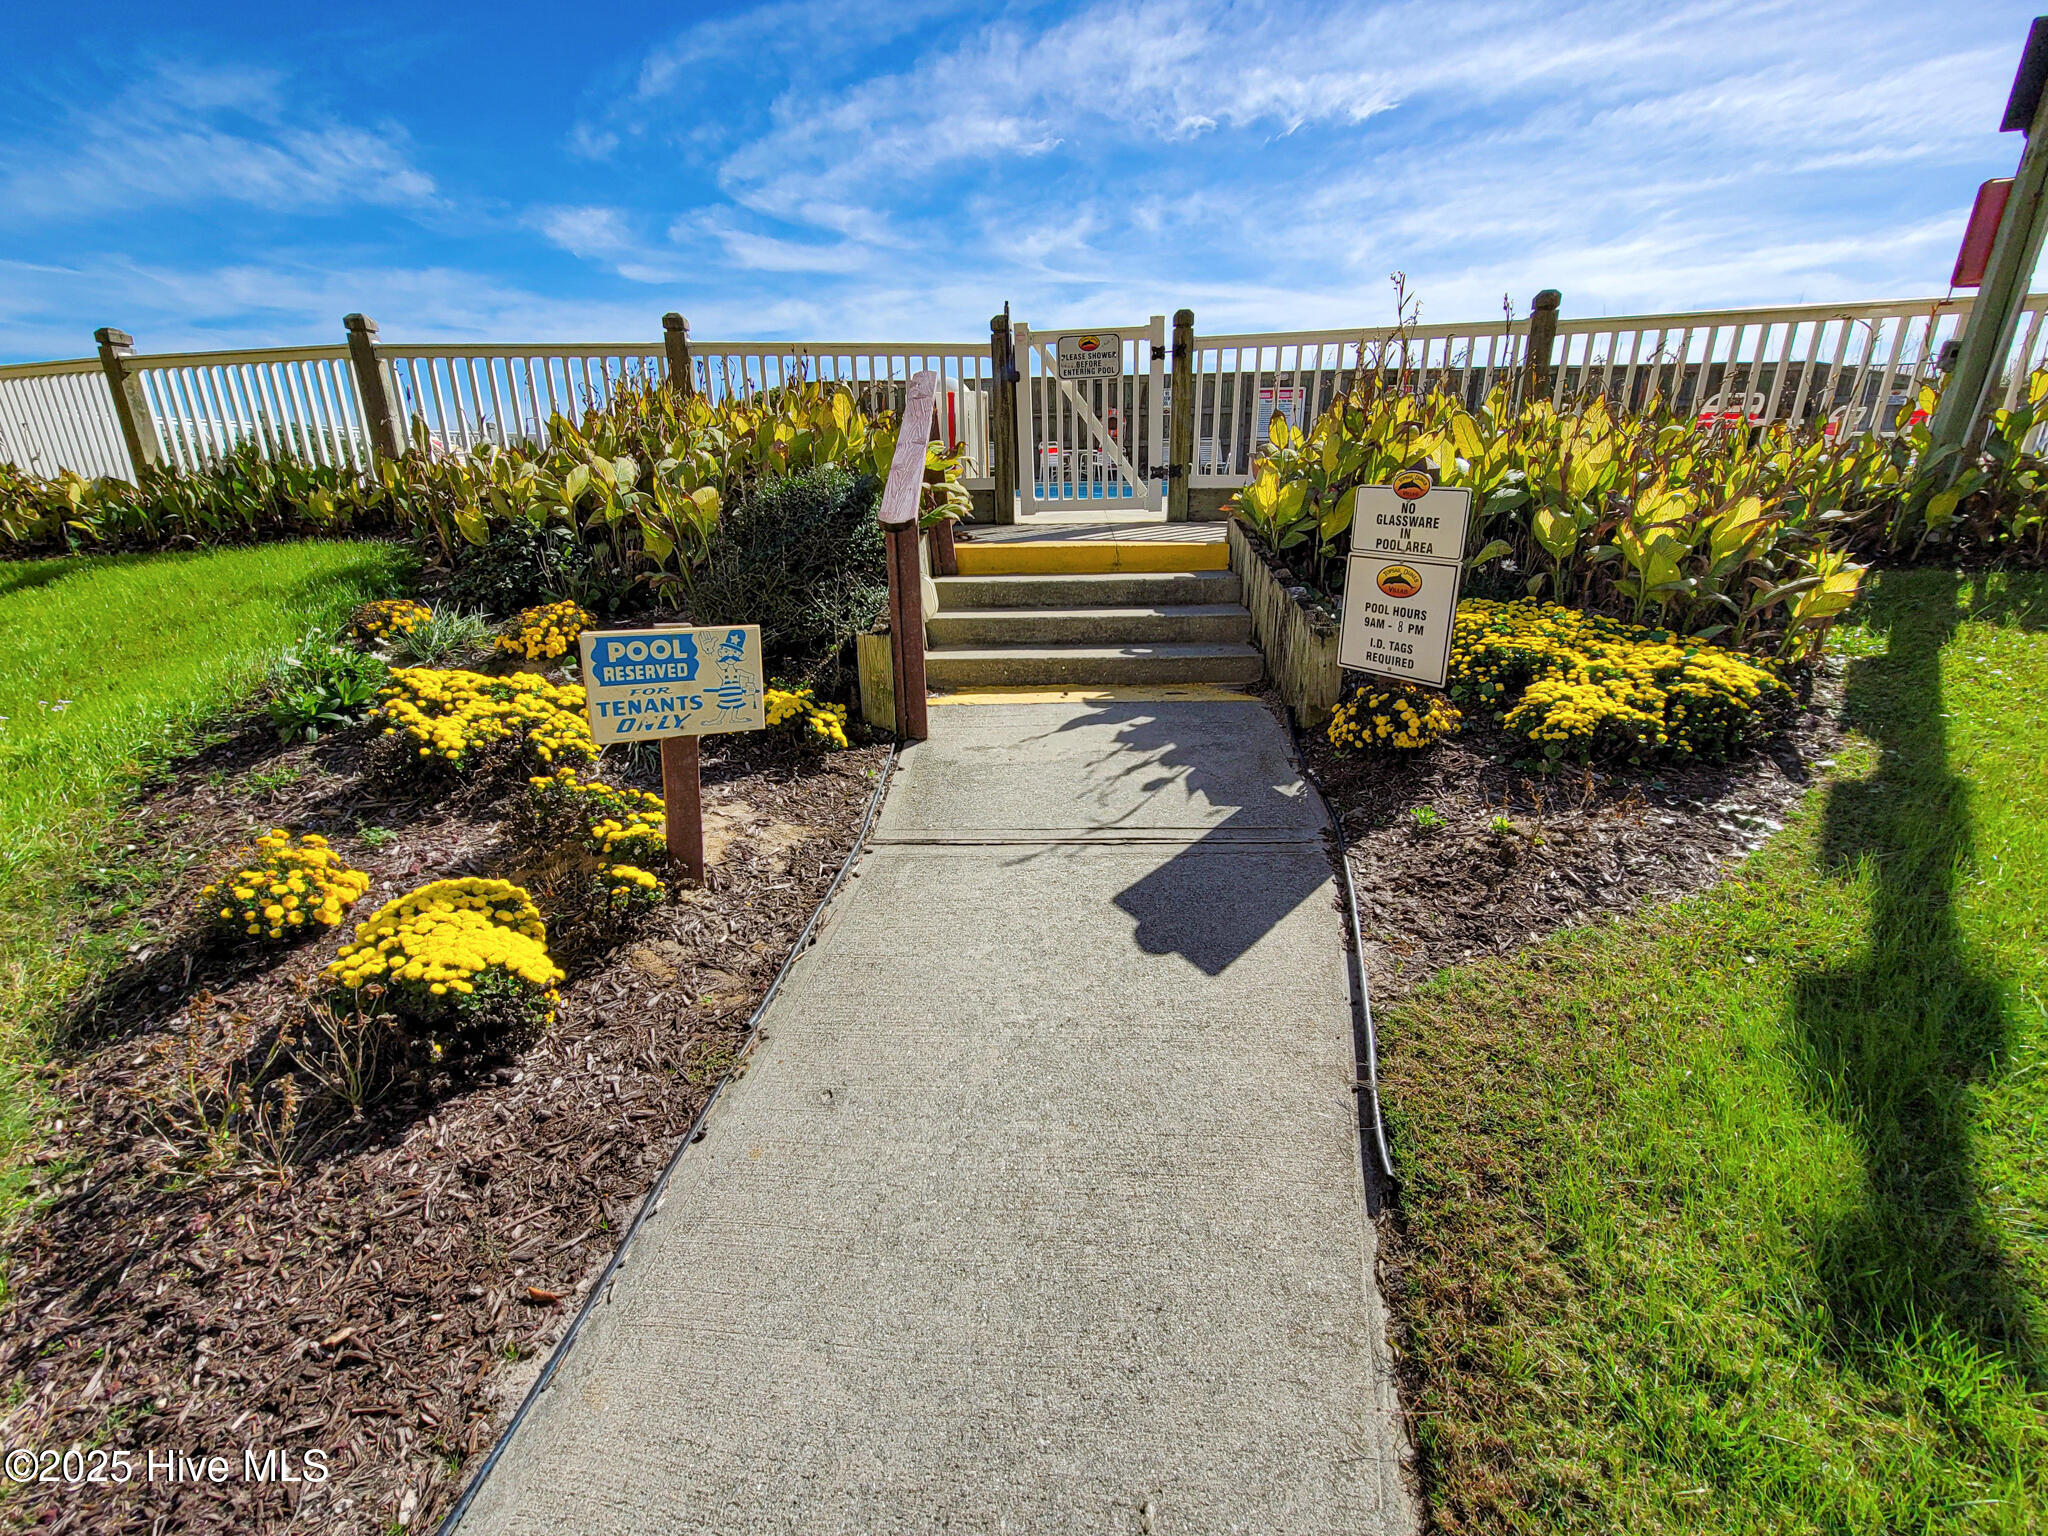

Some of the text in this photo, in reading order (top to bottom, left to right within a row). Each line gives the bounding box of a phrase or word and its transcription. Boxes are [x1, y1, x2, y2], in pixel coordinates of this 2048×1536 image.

[1061, 351, 1117, 361] PLEASE SHOWER
[1076, 360, 1102, 368] BEFORE
[1063, 367, 1096, 376] ENTERING
[1401, 502, 1416, 514] NO
[1376, 513, 1440, 529] GLASSWARE
[1400, 527, 1412, 539] IN
[1376, 538, 1433, 554] POOL AREA
[1364, 602, 1428, 621] POOL HOURS
[1364, 616, 1385, 629] 9AM
[1397, 620, 1404, 633] 8
[1407, 623, 1424, 636] PM
[607, 639, 688, 663] POOL
[1370, 637, 1414, 655] I.D. TAGS
[1365, 650, 1415, 669] REQUIRED
[603, 662, 689, 682] RESERVED
[630, 687, 671, 696] FOR
[596, 694, 703, 718] TENANTS
[616, 713, 692, 734] ONLY
